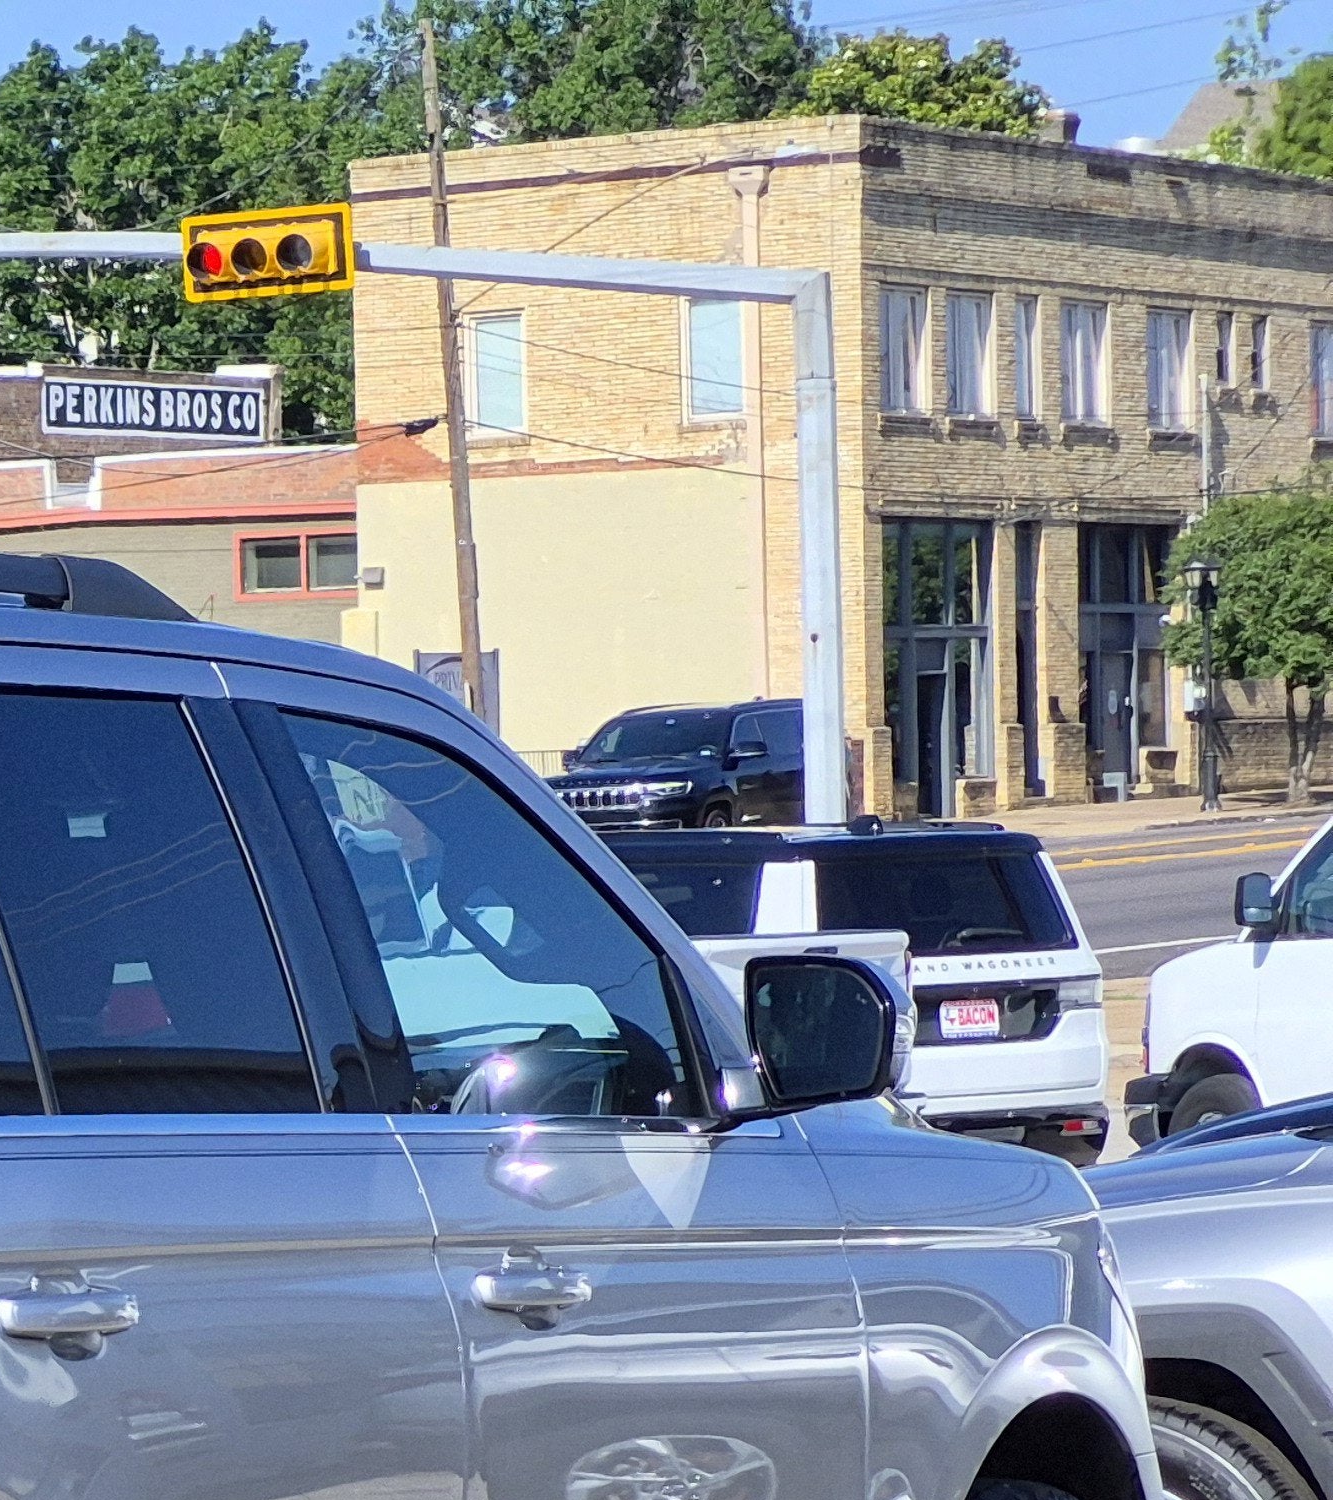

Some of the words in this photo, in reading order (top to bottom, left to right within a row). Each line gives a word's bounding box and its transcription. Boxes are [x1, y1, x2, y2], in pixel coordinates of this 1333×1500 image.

[49, 384, 156, 426] PERKINS
[160, 390, 223, 430] BROS
[227, 393, 257, 431] CO
[434, 670, 463, 692] PRIV
[961, 956, 1057, 971] WAGONEER
[957, 1006, 996, 1027] BACON
